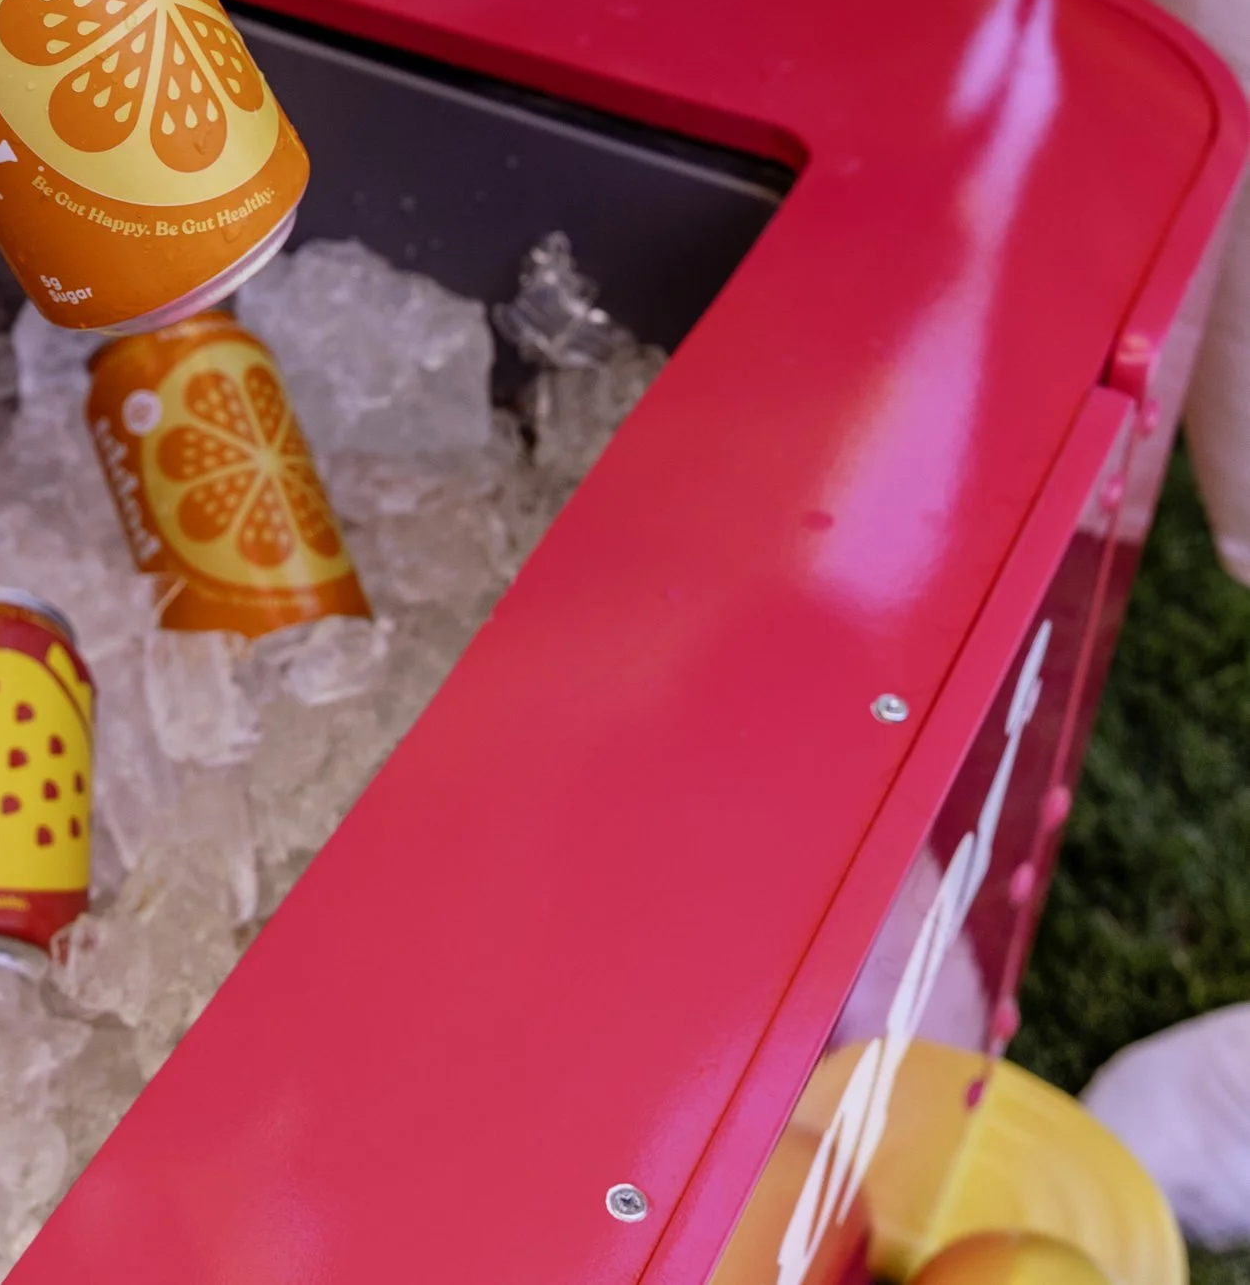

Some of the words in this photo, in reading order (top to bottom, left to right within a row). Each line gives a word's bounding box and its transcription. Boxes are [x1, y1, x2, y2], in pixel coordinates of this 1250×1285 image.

[31, 174, 54, 197] Be
[54, 191, 86, 216] Gut
[87, 207, 151, 238] Happy.
[154, 221, 179, 237] Be
[181, 218, 216, 236] Gut
[216, 184, 276, 228] Healthy.
[39, 274, 63, 292] 5g
[48, 286, 94, 306] Sugar
